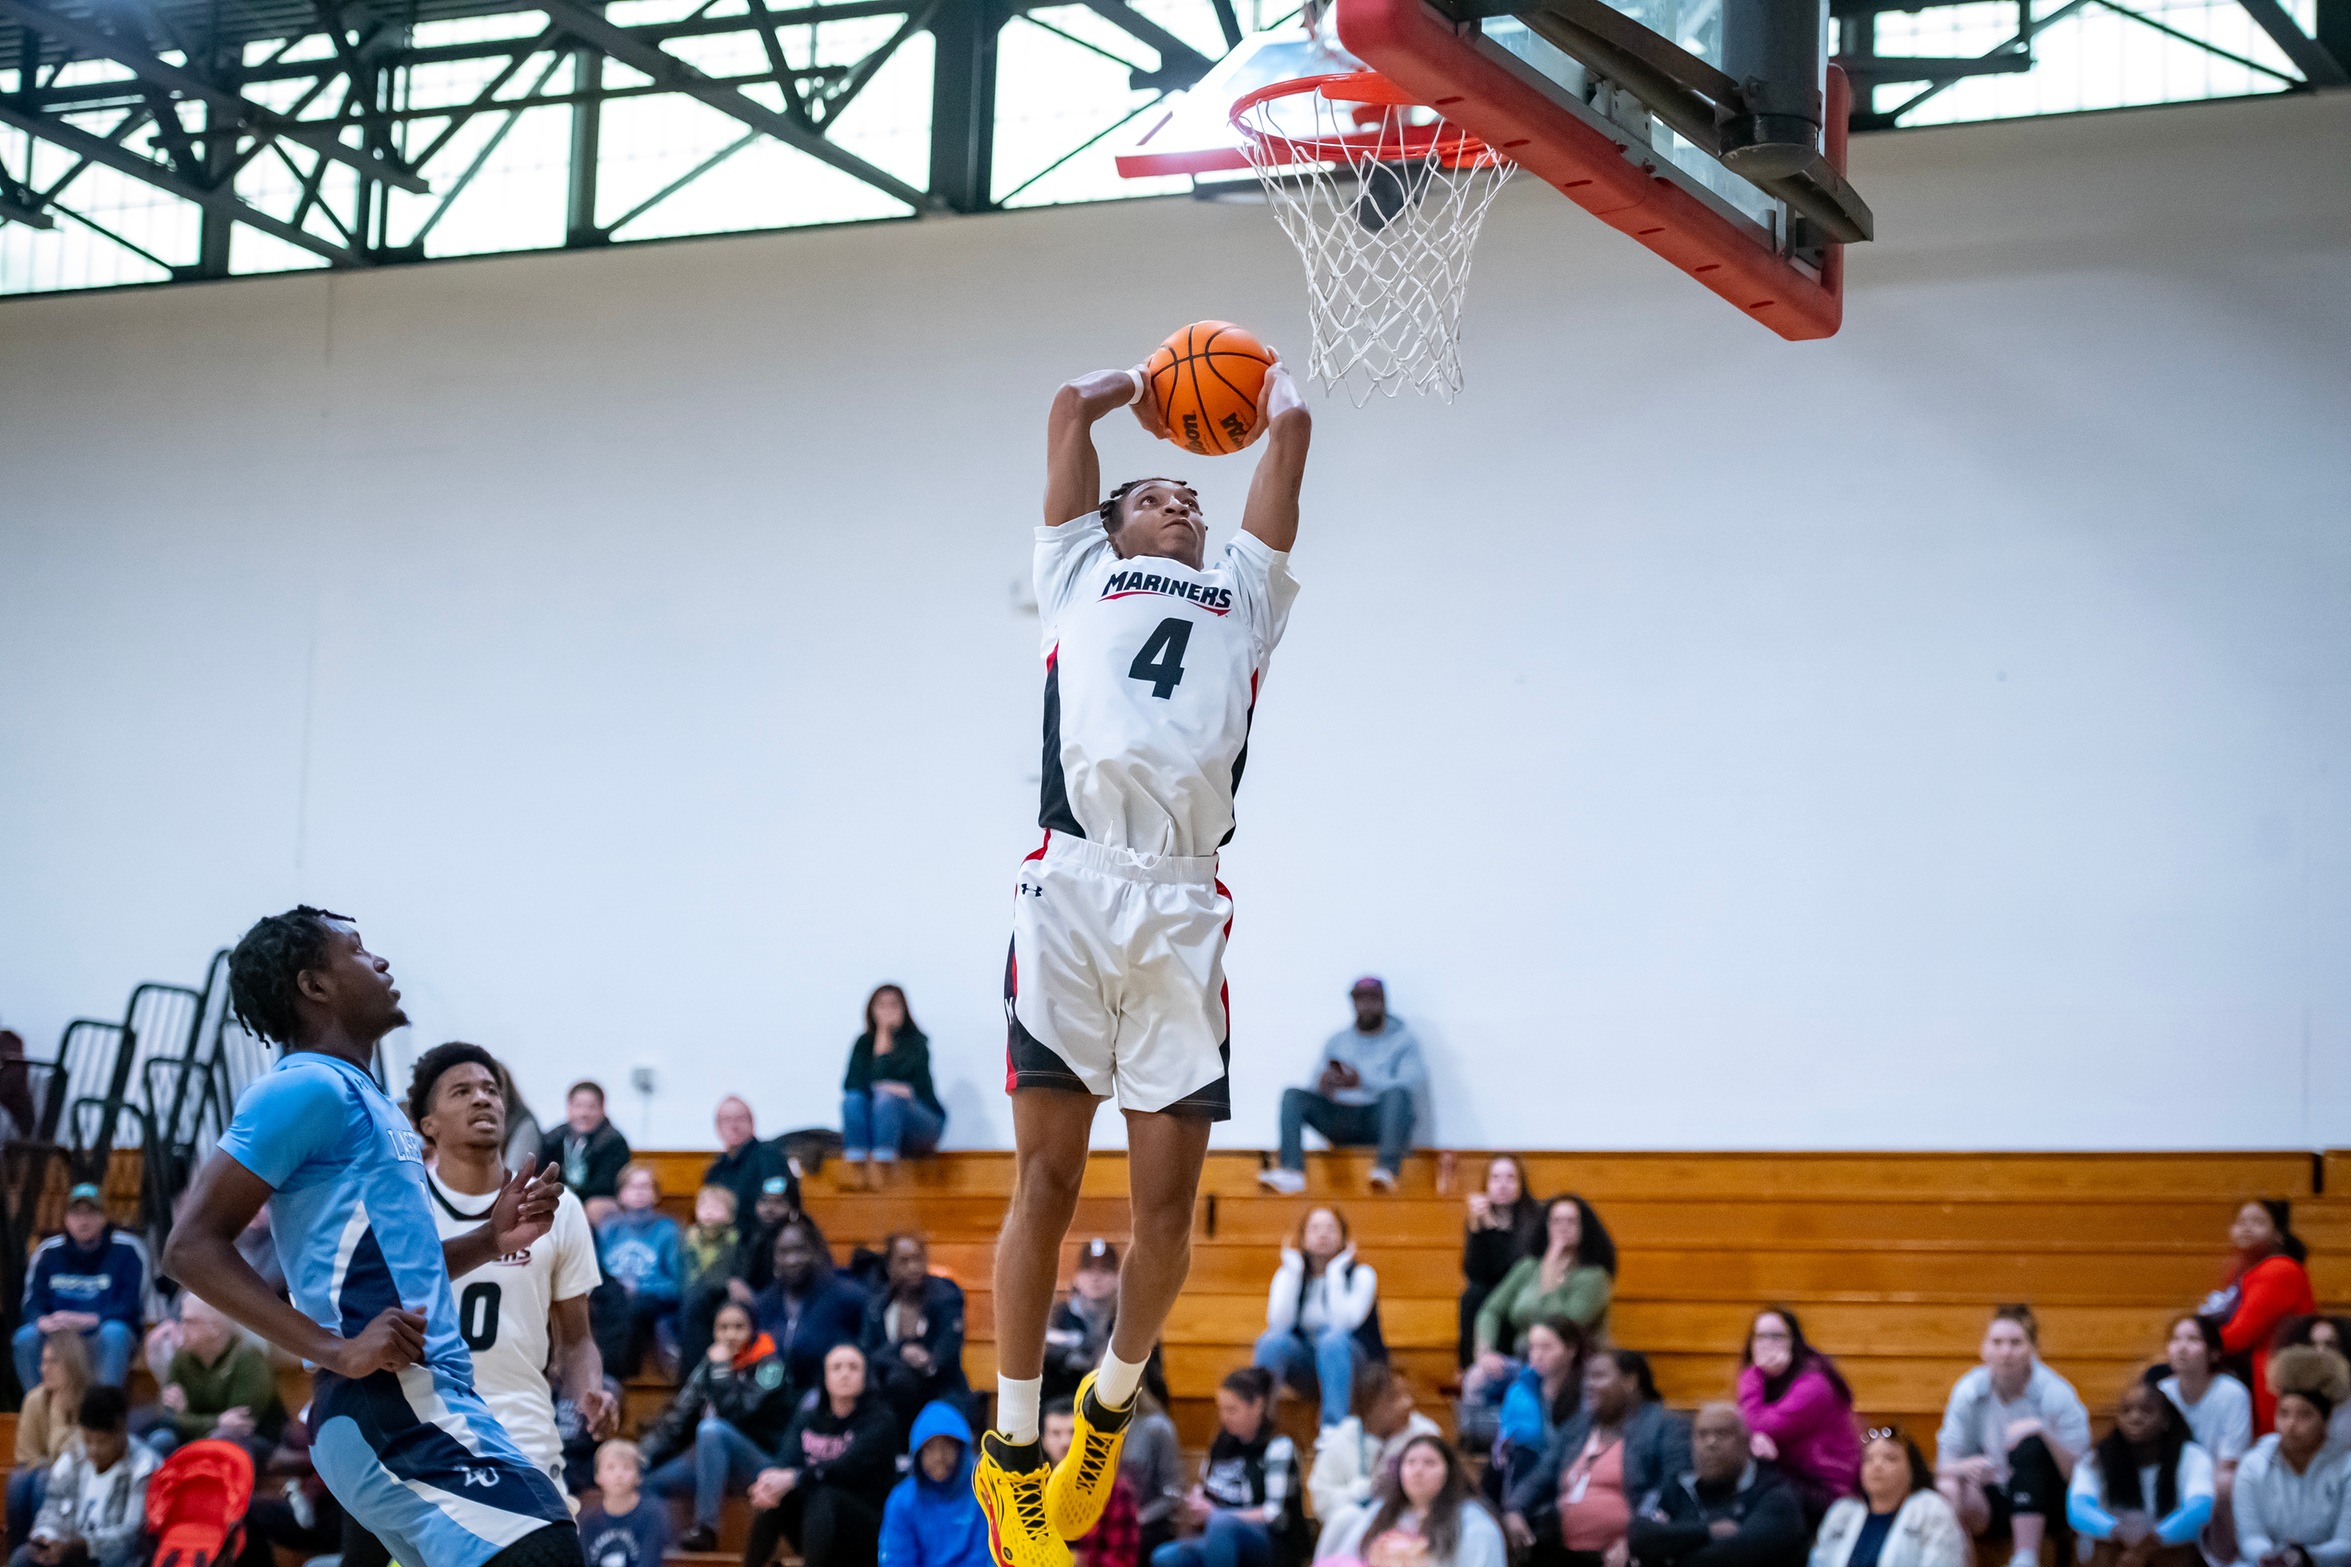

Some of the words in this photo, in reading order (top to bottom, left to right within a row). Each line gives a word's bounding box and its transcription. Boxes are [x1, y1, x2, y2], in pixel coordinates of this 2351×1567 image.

[1101, 571, 1233, 608] MARINERS
[1128, 617, 1194, 700] 4
[460, 1282, 502, 1351] 0
